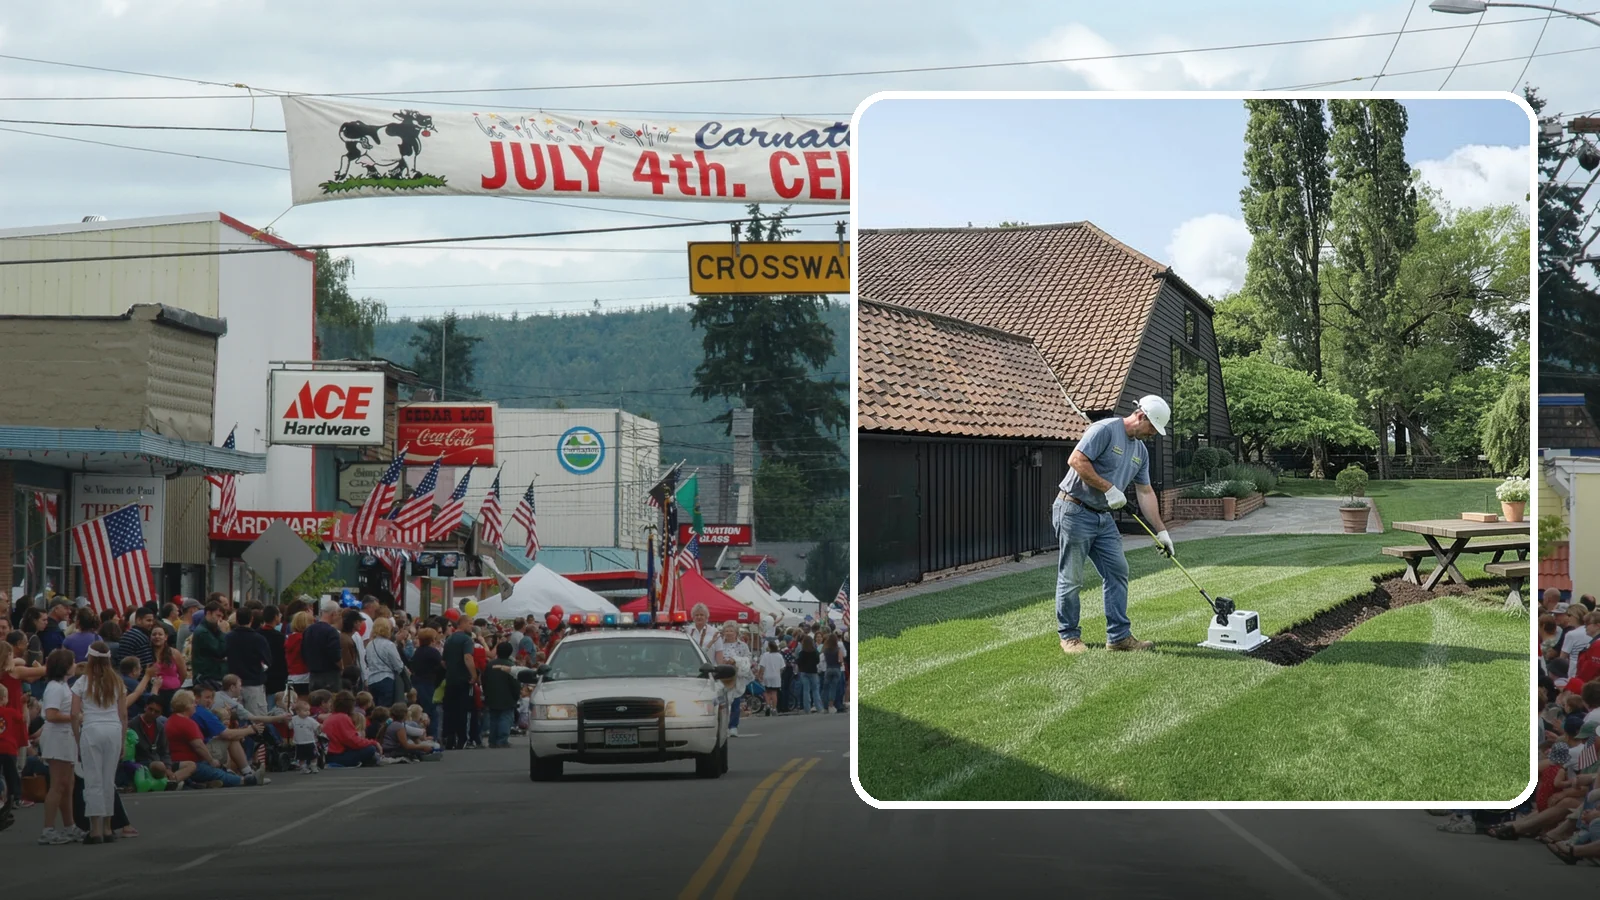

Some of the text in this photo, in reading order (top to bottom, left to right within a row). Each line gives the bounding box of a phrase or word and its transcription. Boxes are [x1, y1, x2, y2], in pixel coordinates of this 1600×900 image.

[481, 141, 605, 192] JULY
[632, 150, 747, 198] 4th.
[696, 254, 850, 280] CROSSWA
[282, 380, 374, 420] ACE
[405, 409, 453, 422] CEDAR
[283, 421, 371, 437] Hardware
[416, 428, 477, 447] Coca-Cola
[353, 467, 384, 480] Simpl
[95, 484, 124, 495] Vincent
[126, 486, 136, 495] de
[137, 485, 155, 496] Paul
[699, 535, 730, 544] GLASS
